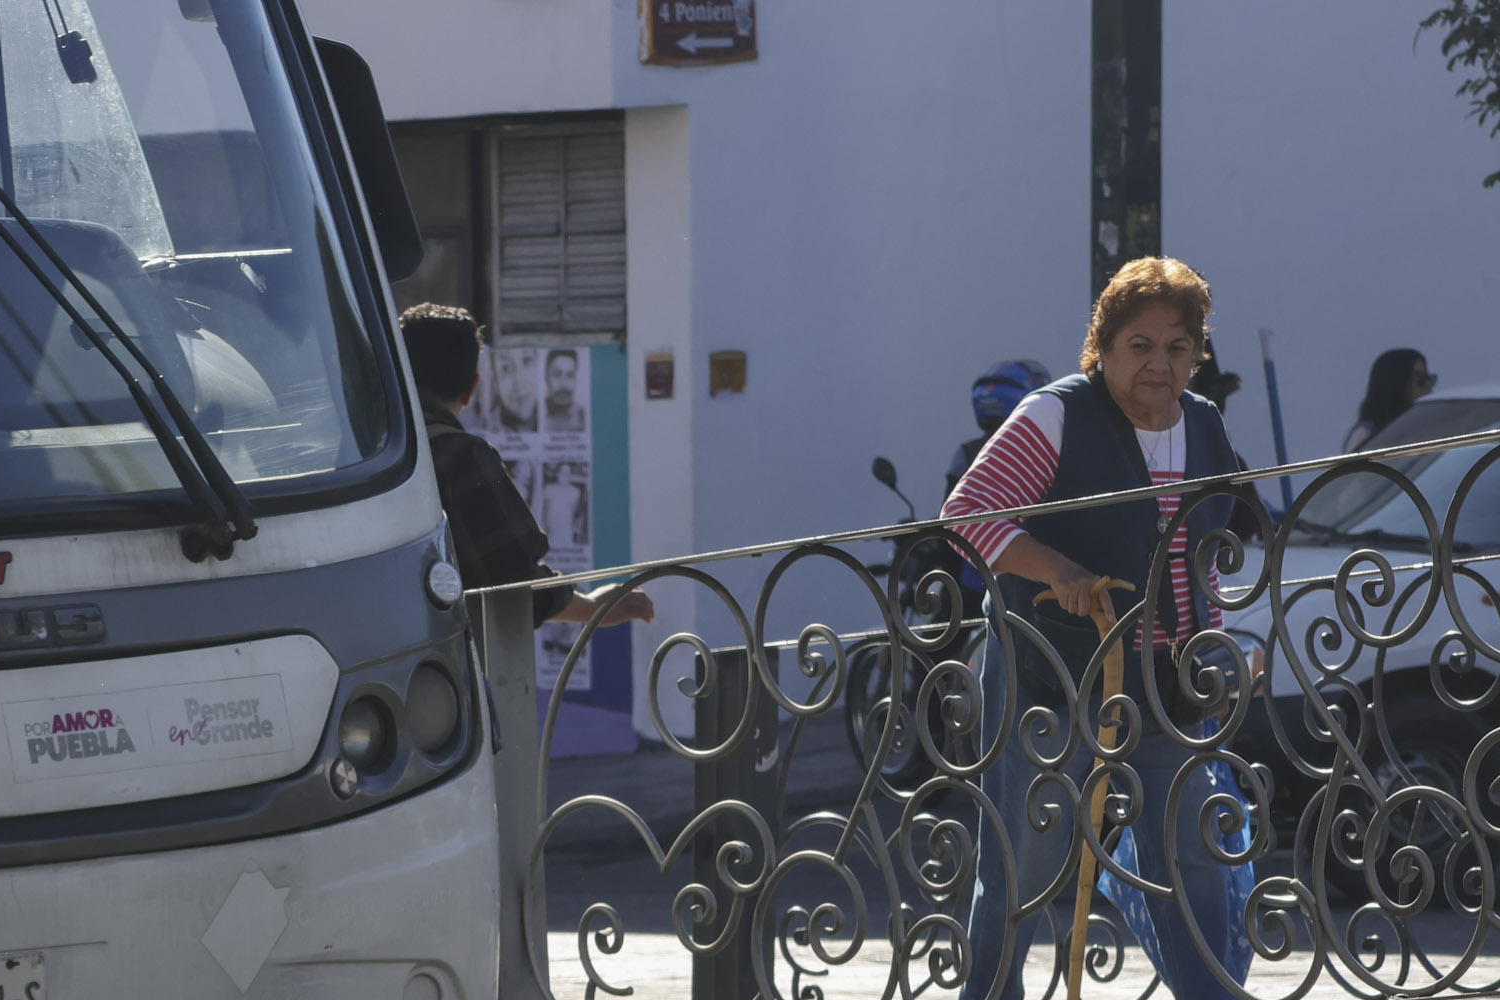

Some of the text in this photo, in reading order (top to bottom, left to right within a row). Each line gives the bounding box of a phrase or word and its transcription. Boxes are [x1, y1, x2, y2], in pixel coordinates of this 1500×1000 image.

[659, 1, 748, 23] 4 Ponien
[24, 721, 51, 737] POR
[52, 708, 115, 734] AMOR
[183, 698, 260, 723] Pensar
[169, 715, 275, 746] en Grande
[27, 728, 136, 764] PUEBLA
